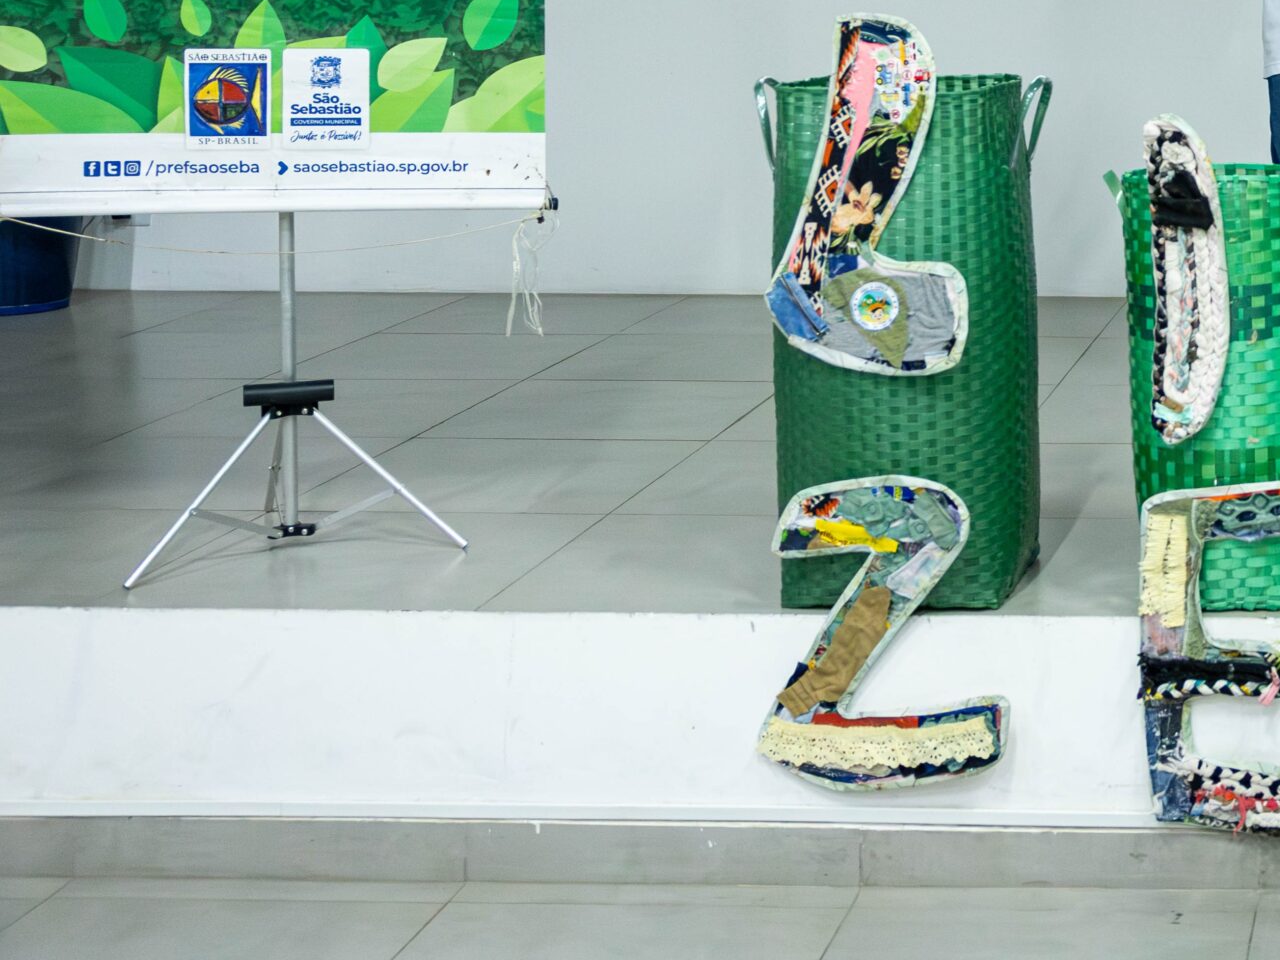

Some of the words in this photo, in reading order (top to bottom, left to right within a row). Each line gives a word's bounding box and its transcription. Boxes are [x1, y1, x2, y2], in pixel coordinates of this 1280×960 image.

[312, 92, 340, 104] São
[290, 103, 362, 115] Sebastião
[145, 159, 260, 178] /prefsaoseba
[293, 159, 469, 178] saosebastiao.sp.gov.br
